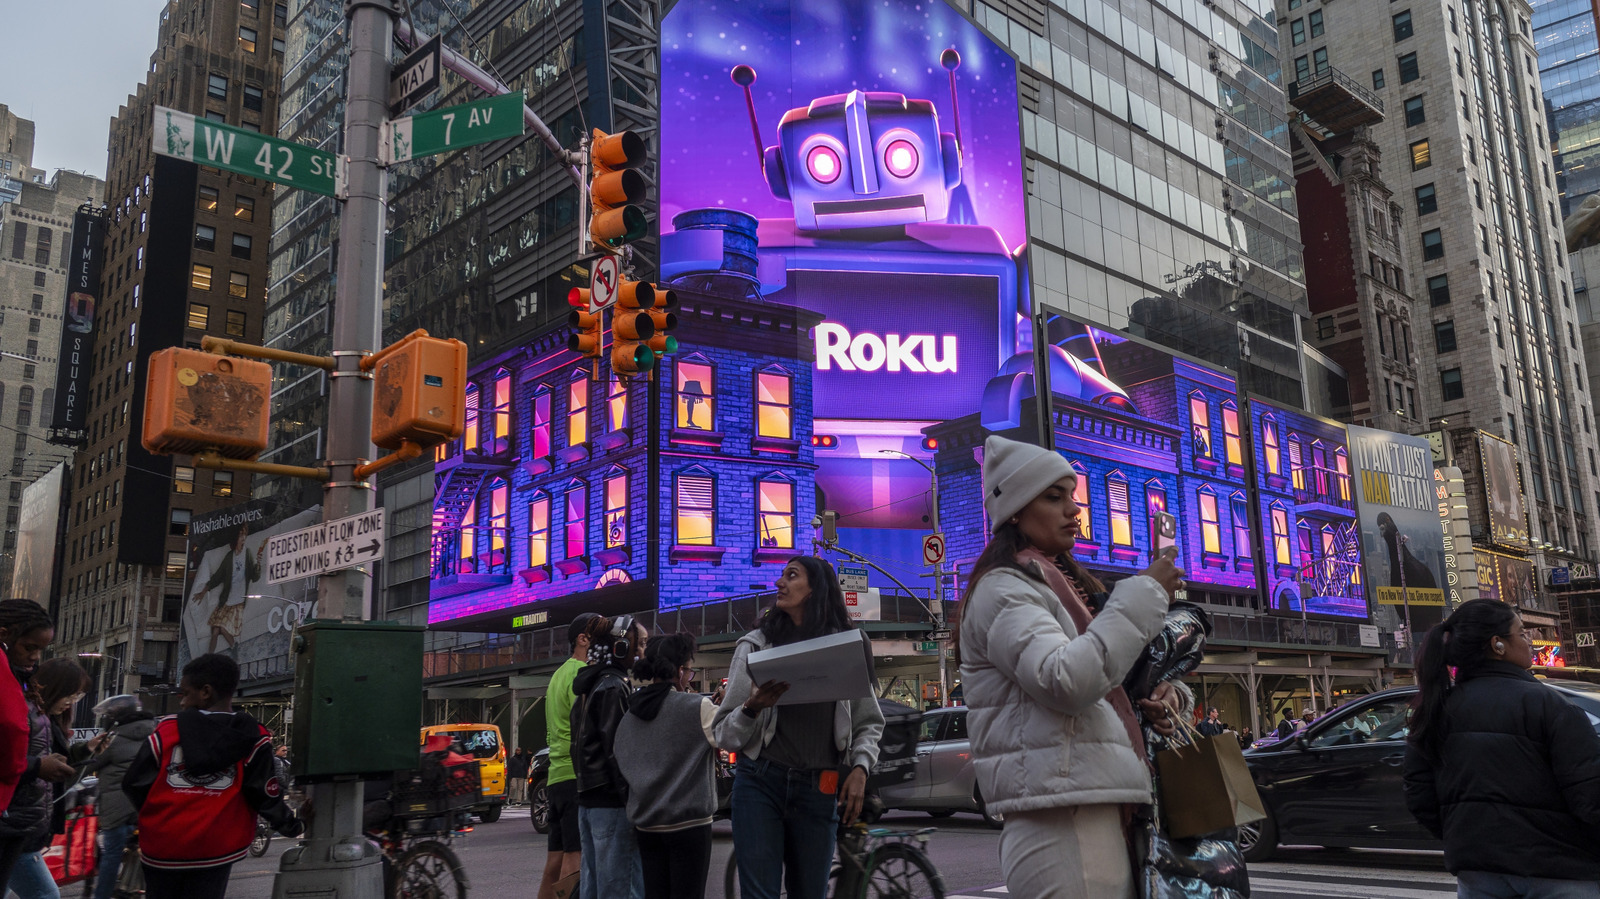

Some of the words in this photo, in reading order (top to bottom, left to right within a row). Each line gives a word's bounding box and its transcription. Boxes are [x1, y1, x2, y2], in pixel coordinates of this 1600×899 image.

[400, 59, 429, 99] WAY
[442, 113, 456, 146] 7
[204, 125, 236, 165] W
[254, 142, 294, 181] 42
[310, 155, 334, 179] St
[80, 220, 94, 288] TIMES
[66, 338, 81, 422] SQUARE
[1357, 437, 1370, 470] IT
[1371, 440, 1401, 475] AIN'T
[1402, 444, 1428, 479] JUST
[1361, 470, 1433, 512] MANHATTAN
[192, 513, 233, 535] Washable
[232, 508, 263, 526] covers.
[270, 527, 327, 558] PEDESTRIAN
[328, 520, 355, 543] FLOW
[357, 513, 382, 535] ZONE
[1433, 468, 1462, 604] AMSTERDA
[269, 560, 292, 580] KEEP
[294, 550, 330, 575] MOVING
[1477, 566, 1494, 586] GIC
[74, 729, 99, 739] NY
